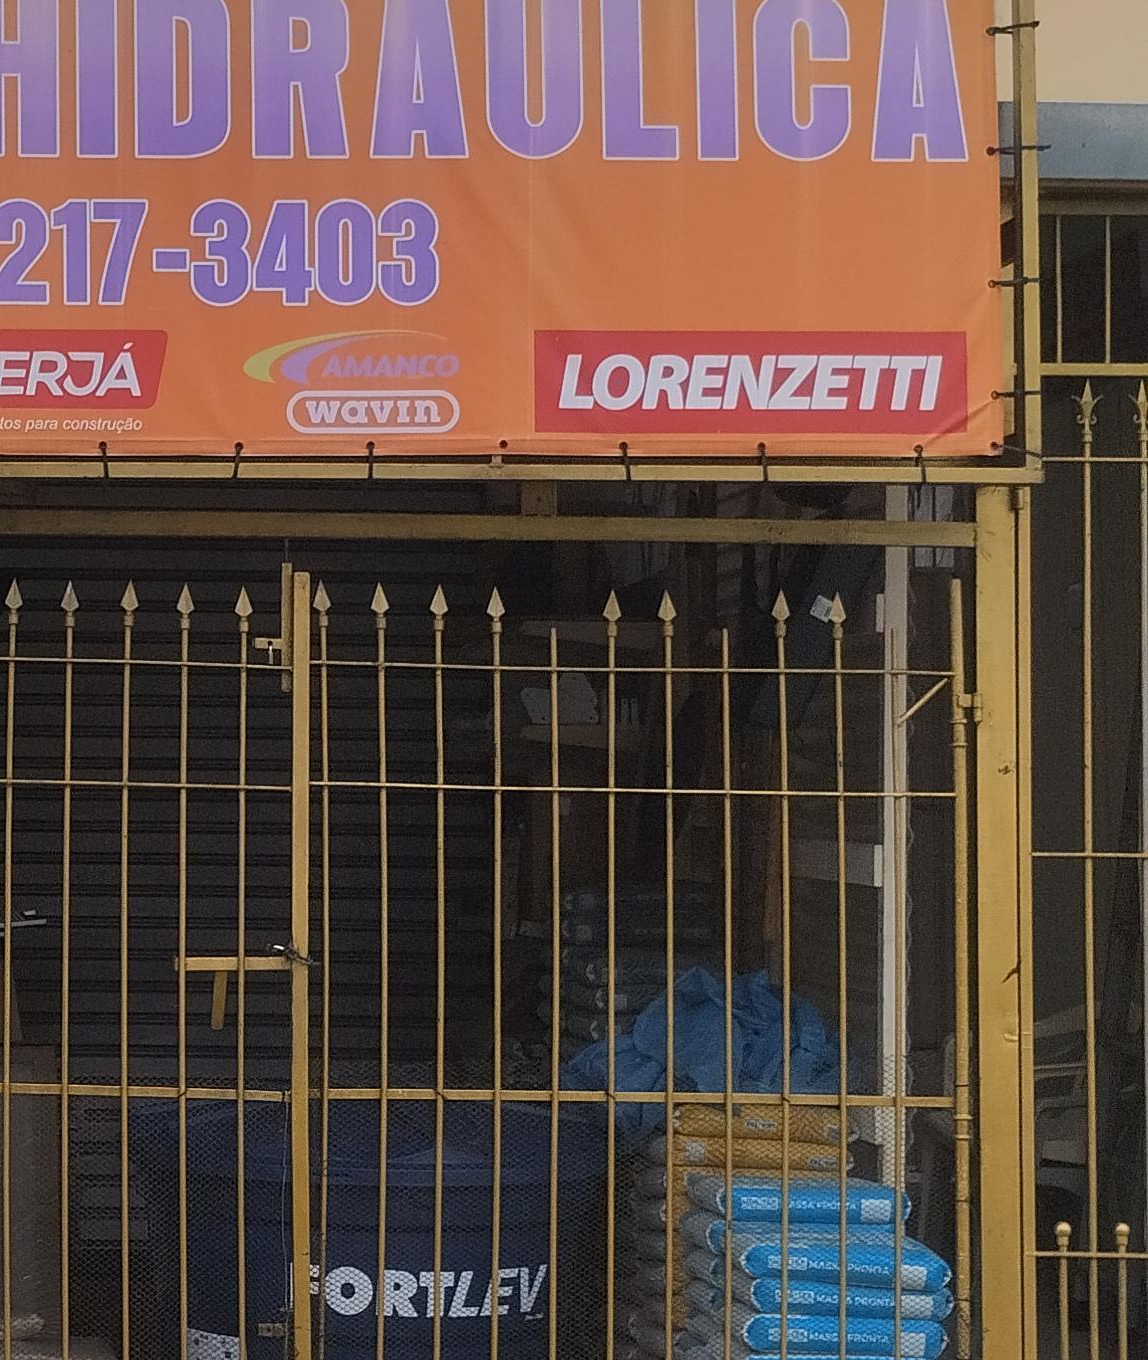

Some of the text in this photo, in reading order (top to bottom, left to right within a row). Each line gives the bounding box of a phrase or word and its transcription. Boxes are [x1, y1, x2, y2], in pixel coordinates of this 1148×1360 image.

[323, 354, 460, 378] AMANCO
[558, 354, 942, 410] LORENZETTI
[306, 400, 440, 423] wavin
[25, 419, 58, 432] para
[63, 417, 143, 433] construção
